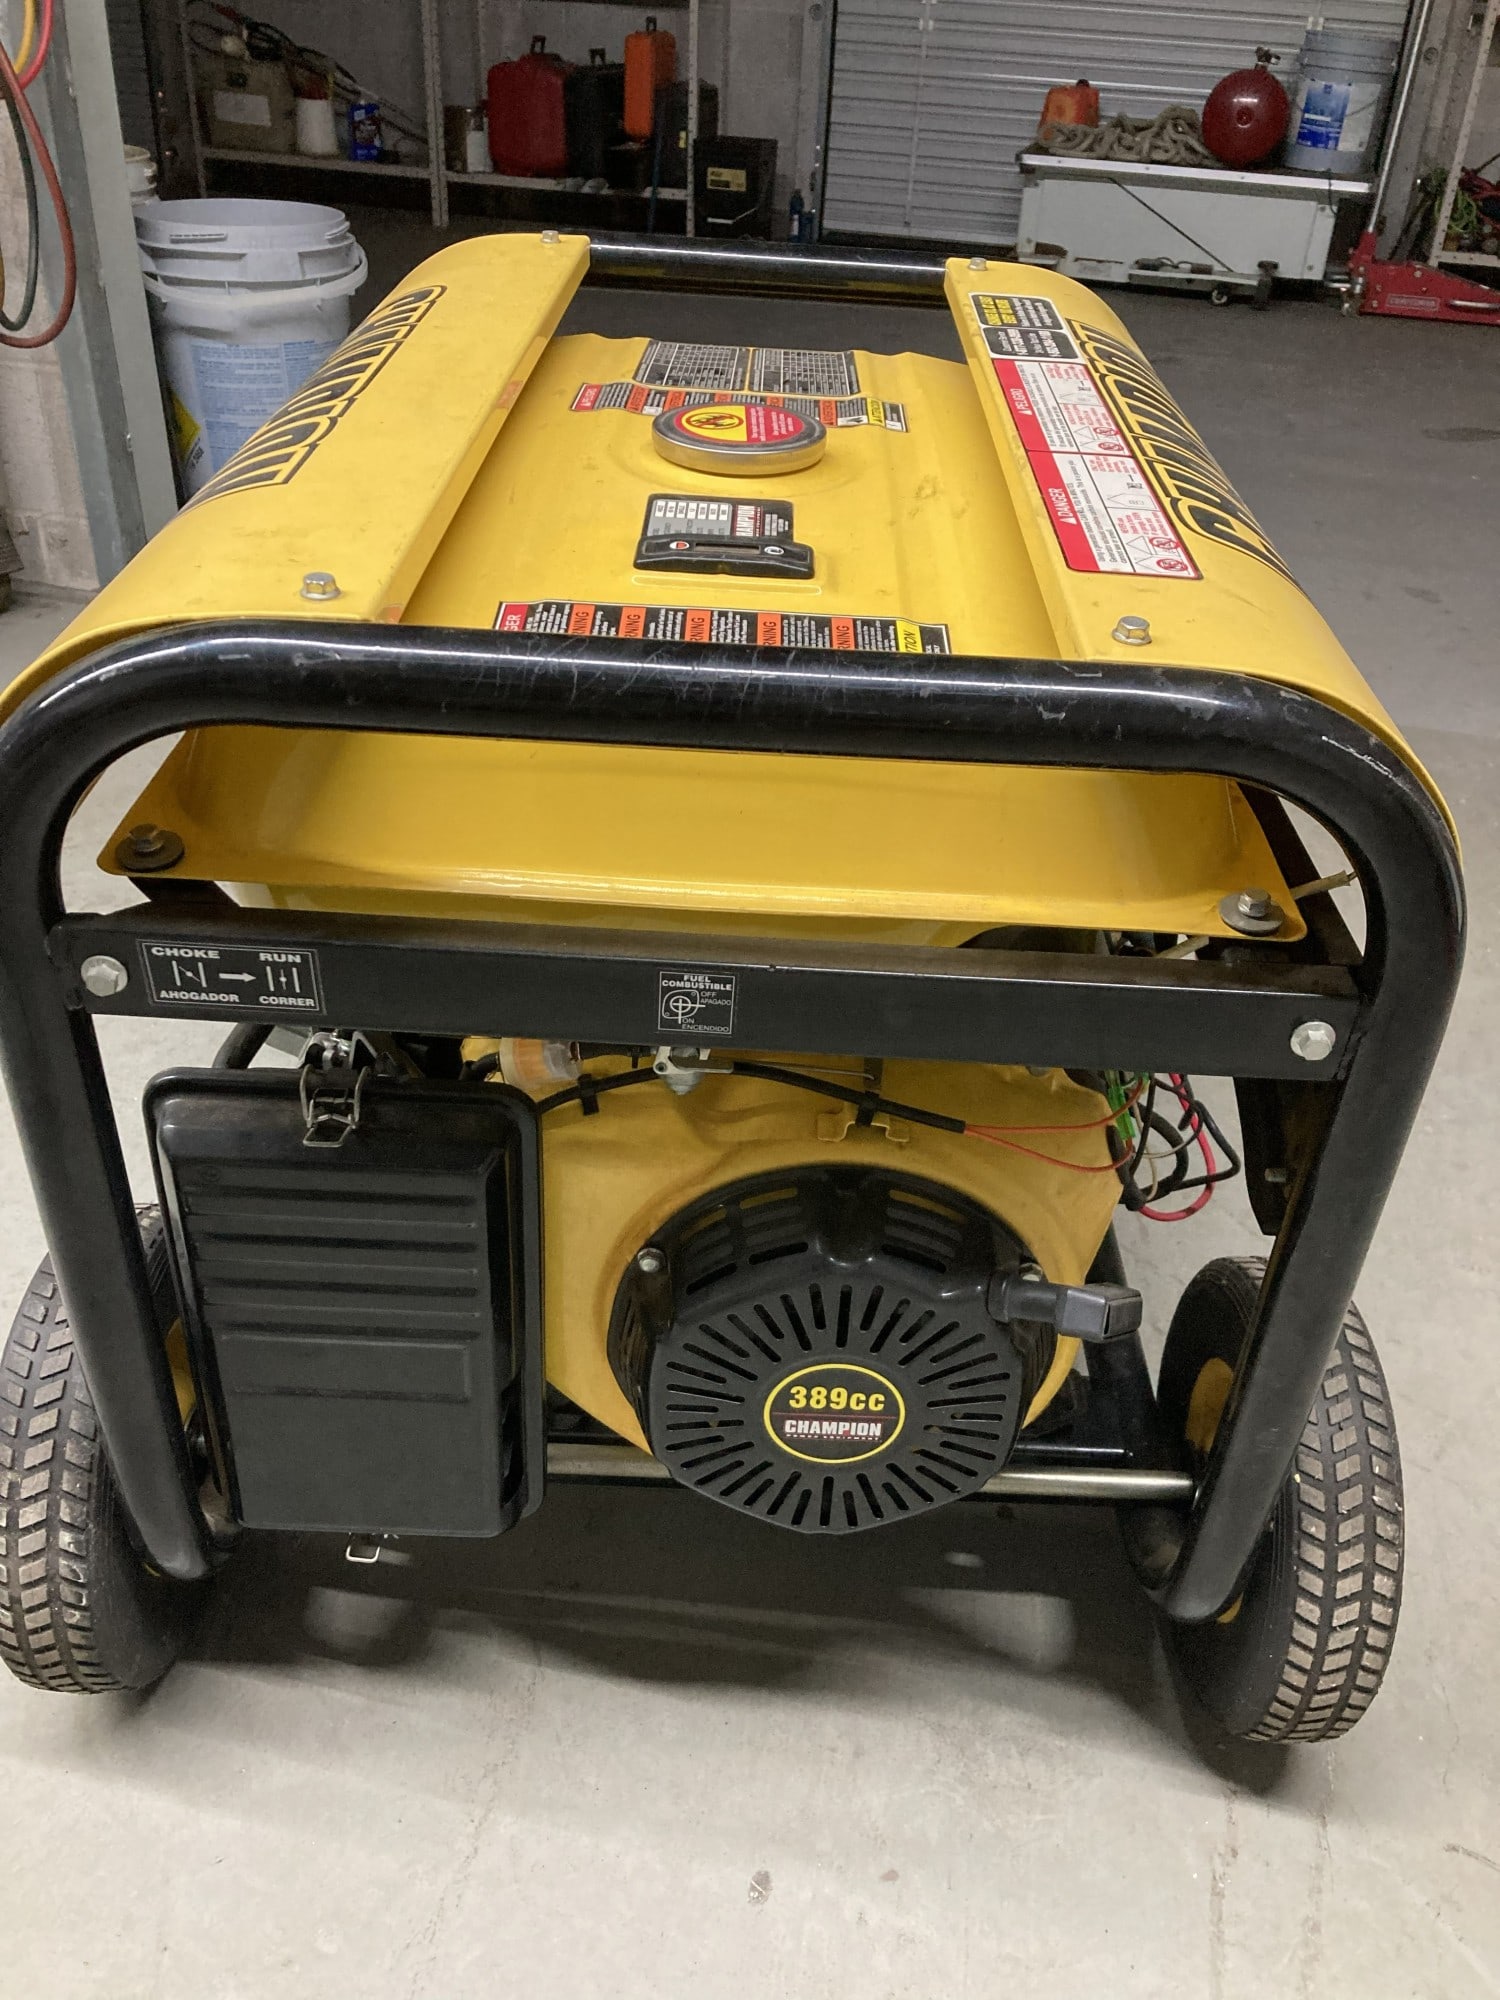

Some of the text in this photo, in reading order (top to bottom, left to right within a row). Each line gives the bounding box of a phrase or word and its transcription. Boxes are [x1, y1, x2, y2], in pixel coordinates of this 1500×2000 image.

[1049, 488, 1071, 519] DANGER
[736, 505, 755, 536] HAMPION
[505, 615, 521, 631] GER
[690, 617, 705, 641] RNING
[764, 620, 776, 646] RNING
[152, 947, 220, 959] CHOKE
[259, 953, 301, 963] RUN
[662, 980, 732, 990] COMBUSTIBLE
[160, 990, 240, 1003] AHOGADOR
[259, 996, 315, 1007] CORRER
[789, 1386, 886, 1411] 389cc
[785, 1420, 882, 1436] CHAMPION
